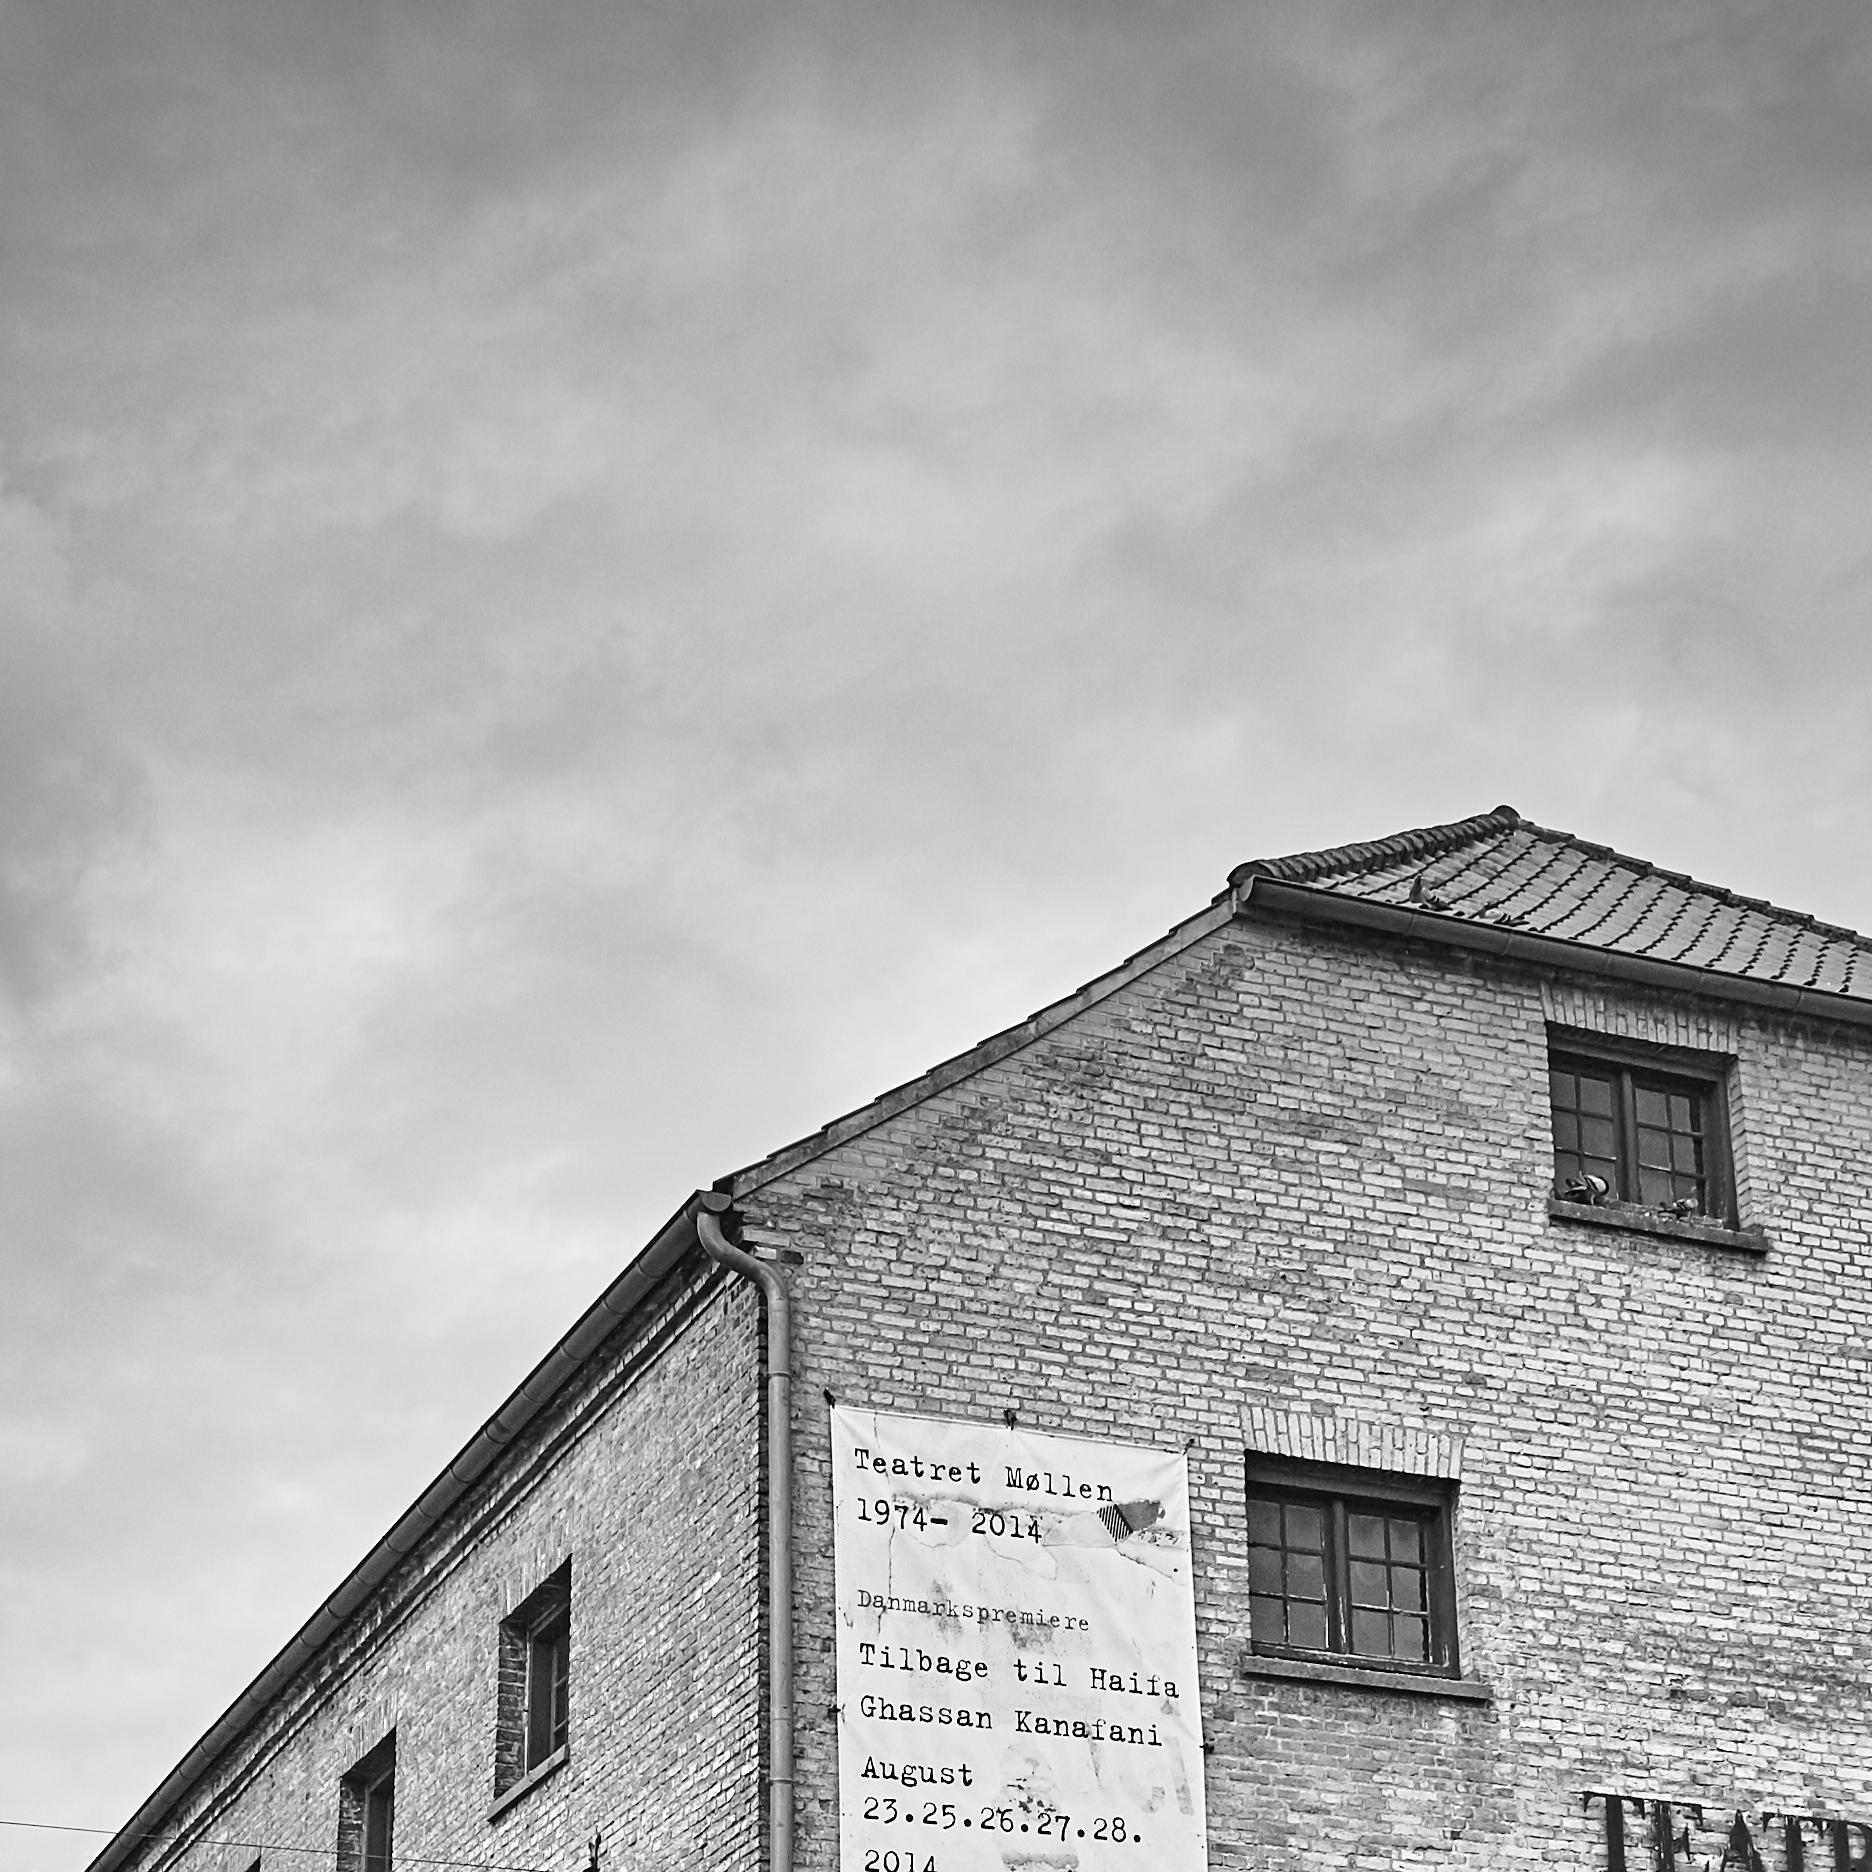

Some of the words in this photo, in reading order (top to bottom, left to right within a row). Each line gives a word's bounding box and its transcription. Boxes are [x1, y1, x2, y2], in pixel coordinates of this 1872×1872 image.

[855, 1448, 980, 1483] Teatret
[1005, 1467, 1112, 1501] Møllen
[858, 1498, 948, 1531] 1974-
[972, 1508, 1041, 1543] 2014
[857, 1589, 1089, 1631] Danmarkspremiere
[860, 1643, 987, 1681] Tilbage
[1014, 1659, 1066, 1686] til
[1090, 1668, 1179, 1698] Haifa
[861, 1695, 992, 1728] Ghassan
[1015, 1711, 1162, 1746] Kanafani
[861, 1757, 972, 1787] August
